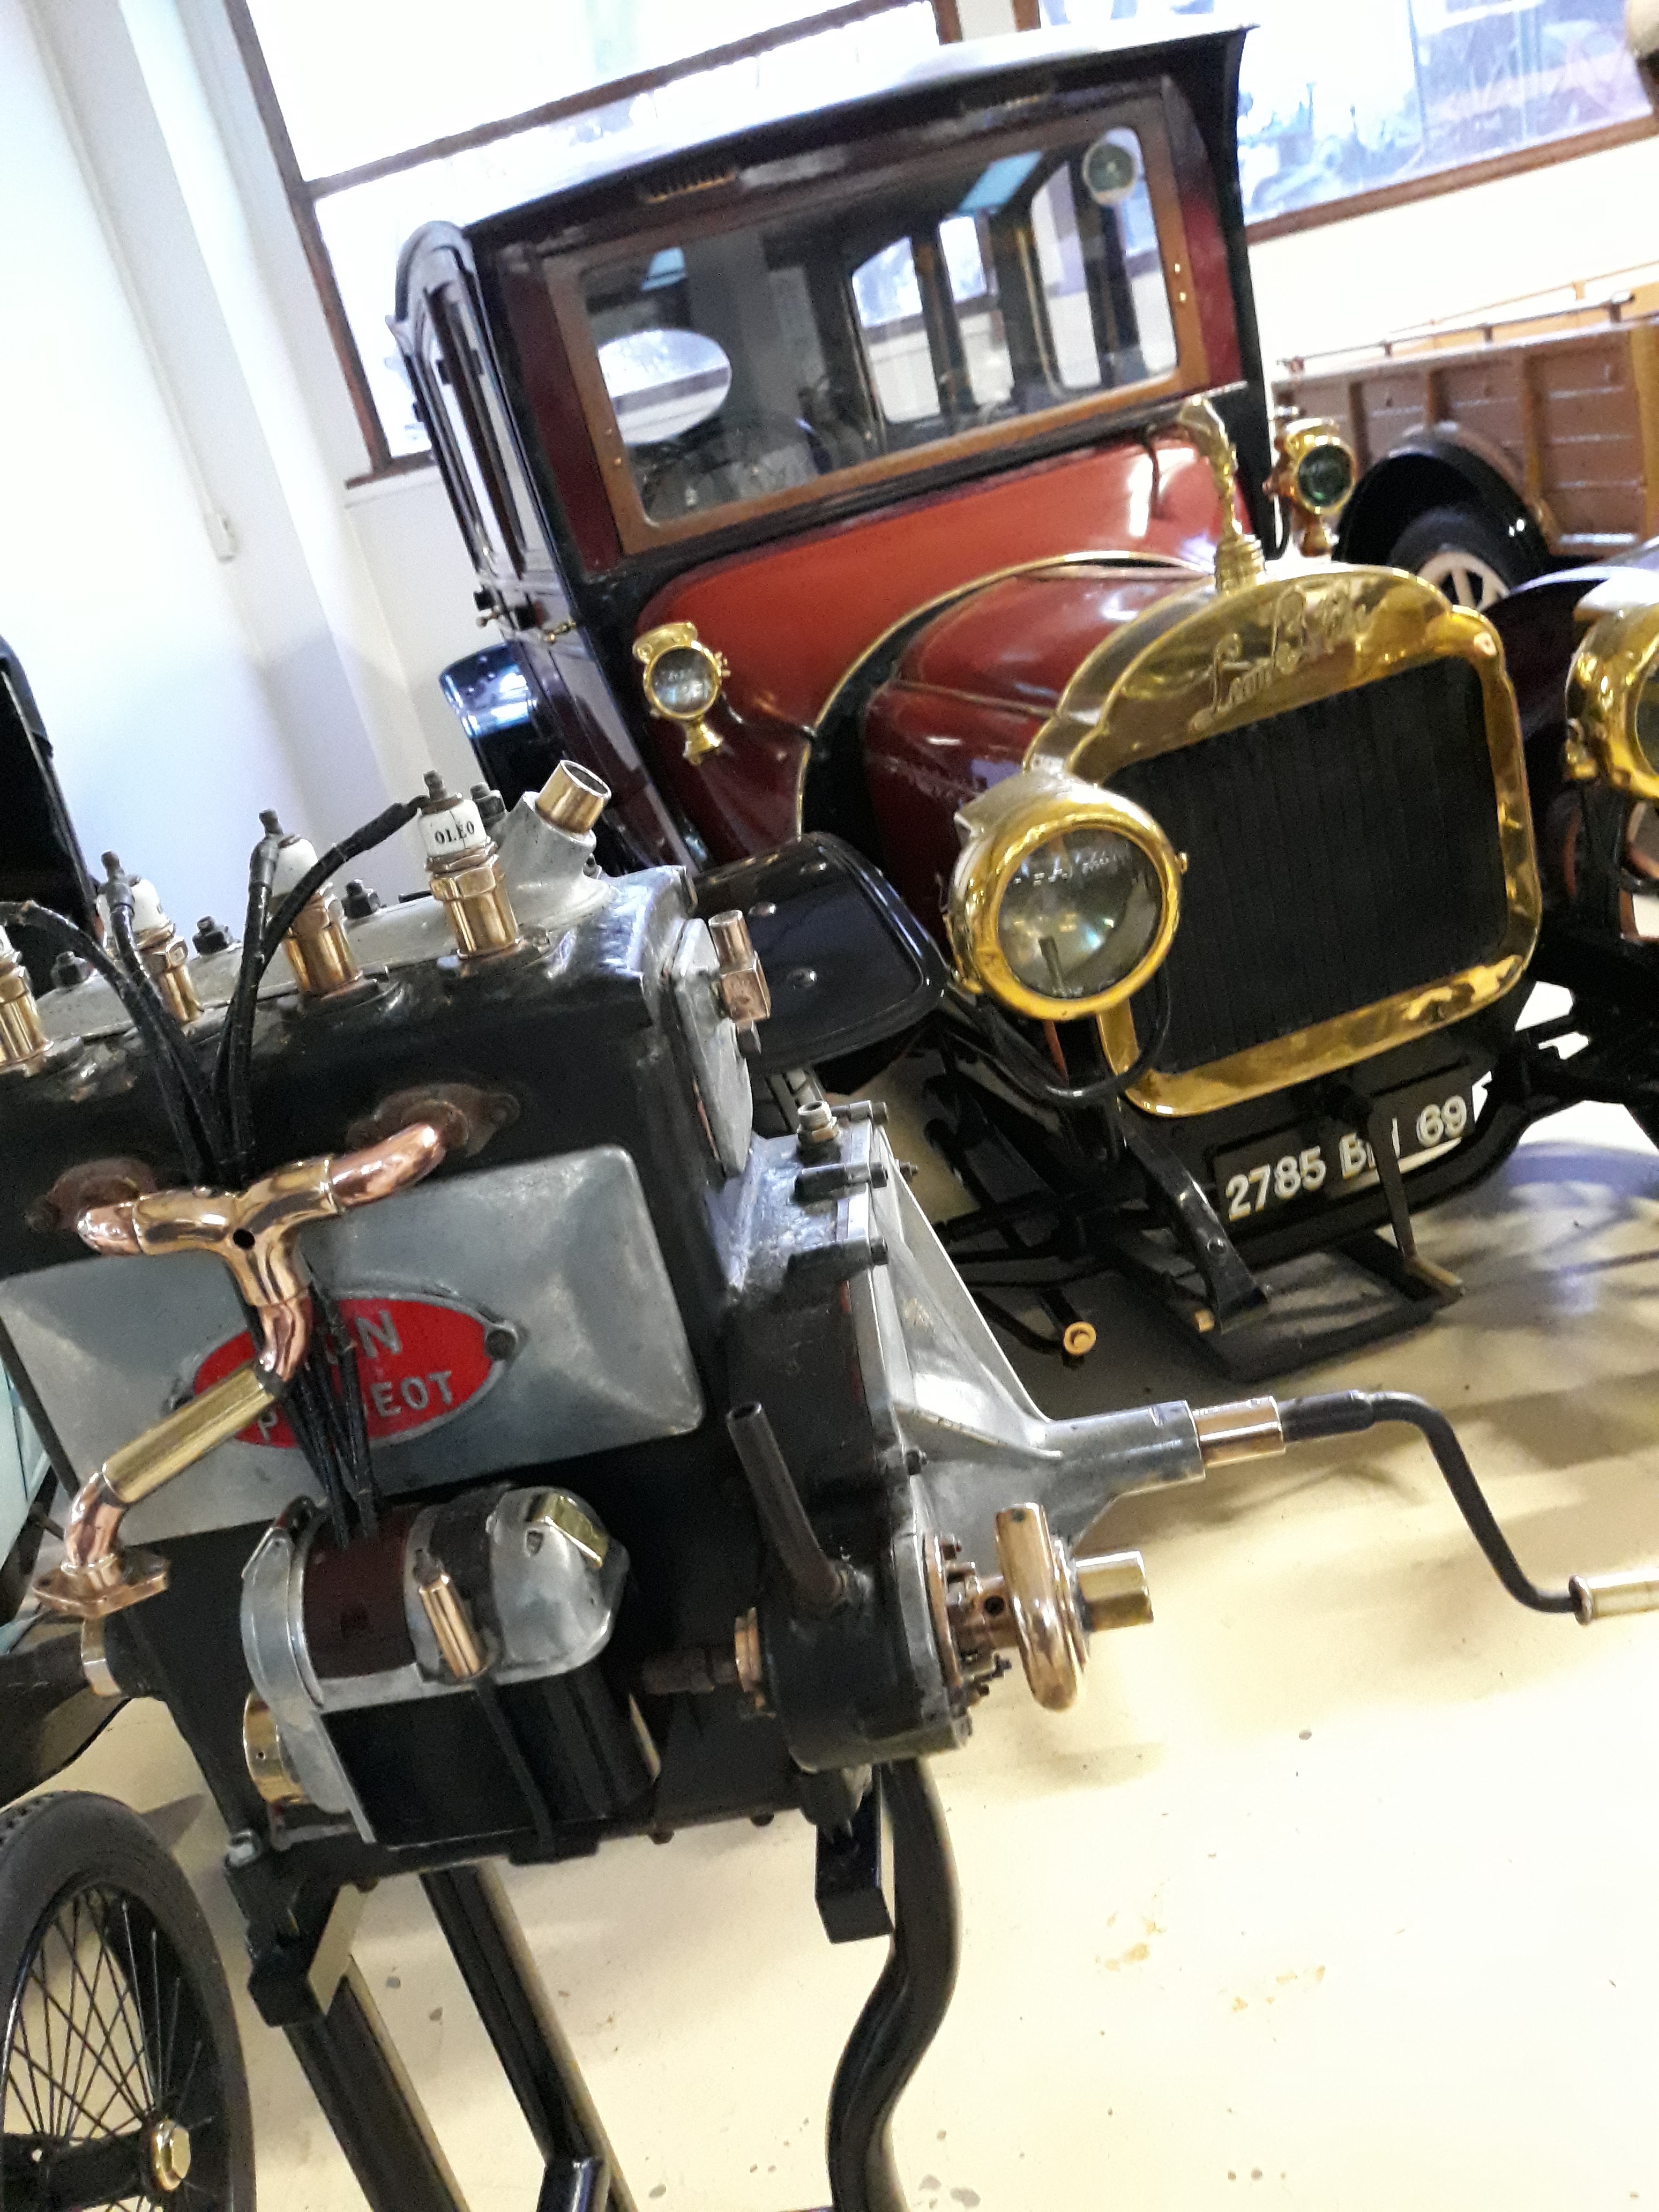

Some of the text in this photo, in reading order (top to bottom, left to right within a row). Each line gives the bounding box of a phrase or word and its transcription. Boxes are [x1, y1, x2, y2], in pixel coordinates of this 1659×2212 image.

[1225, 1145, 1327, 1222] 2785
[1416, 1094, 1468, 1148] 69
[256, 1370, 454, 1441] PEOT
